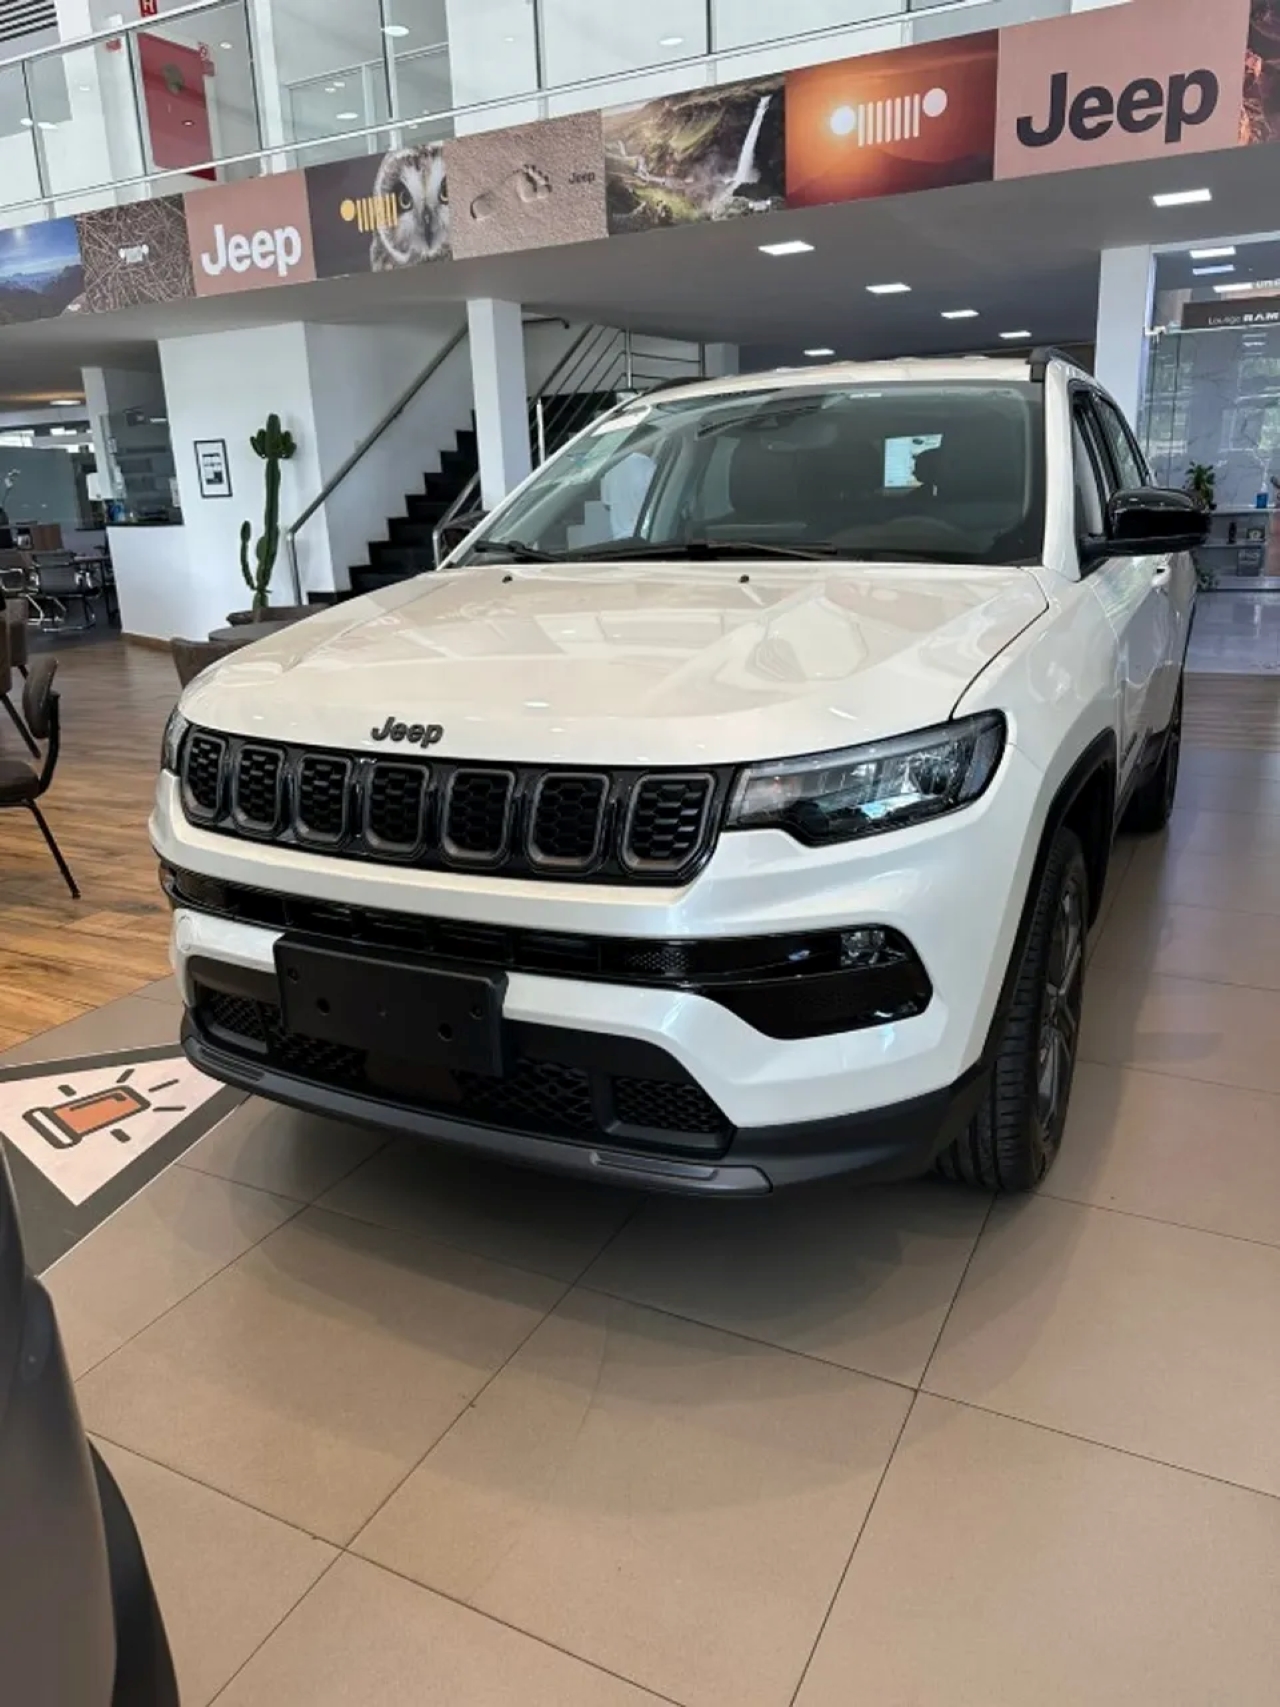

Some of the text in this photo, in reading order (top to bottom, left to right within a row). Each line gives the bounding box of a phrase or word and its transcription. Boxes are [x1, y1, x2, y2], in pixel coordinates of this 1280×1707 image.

[1016, 68, 1219, 147] Jeep
[568, 171, 596, 184] Jeep
[200, 224, 302, 277] Jeep
[1243, 311, 1279, 322] RAM
[371, 716, 444, 749] Jeep
